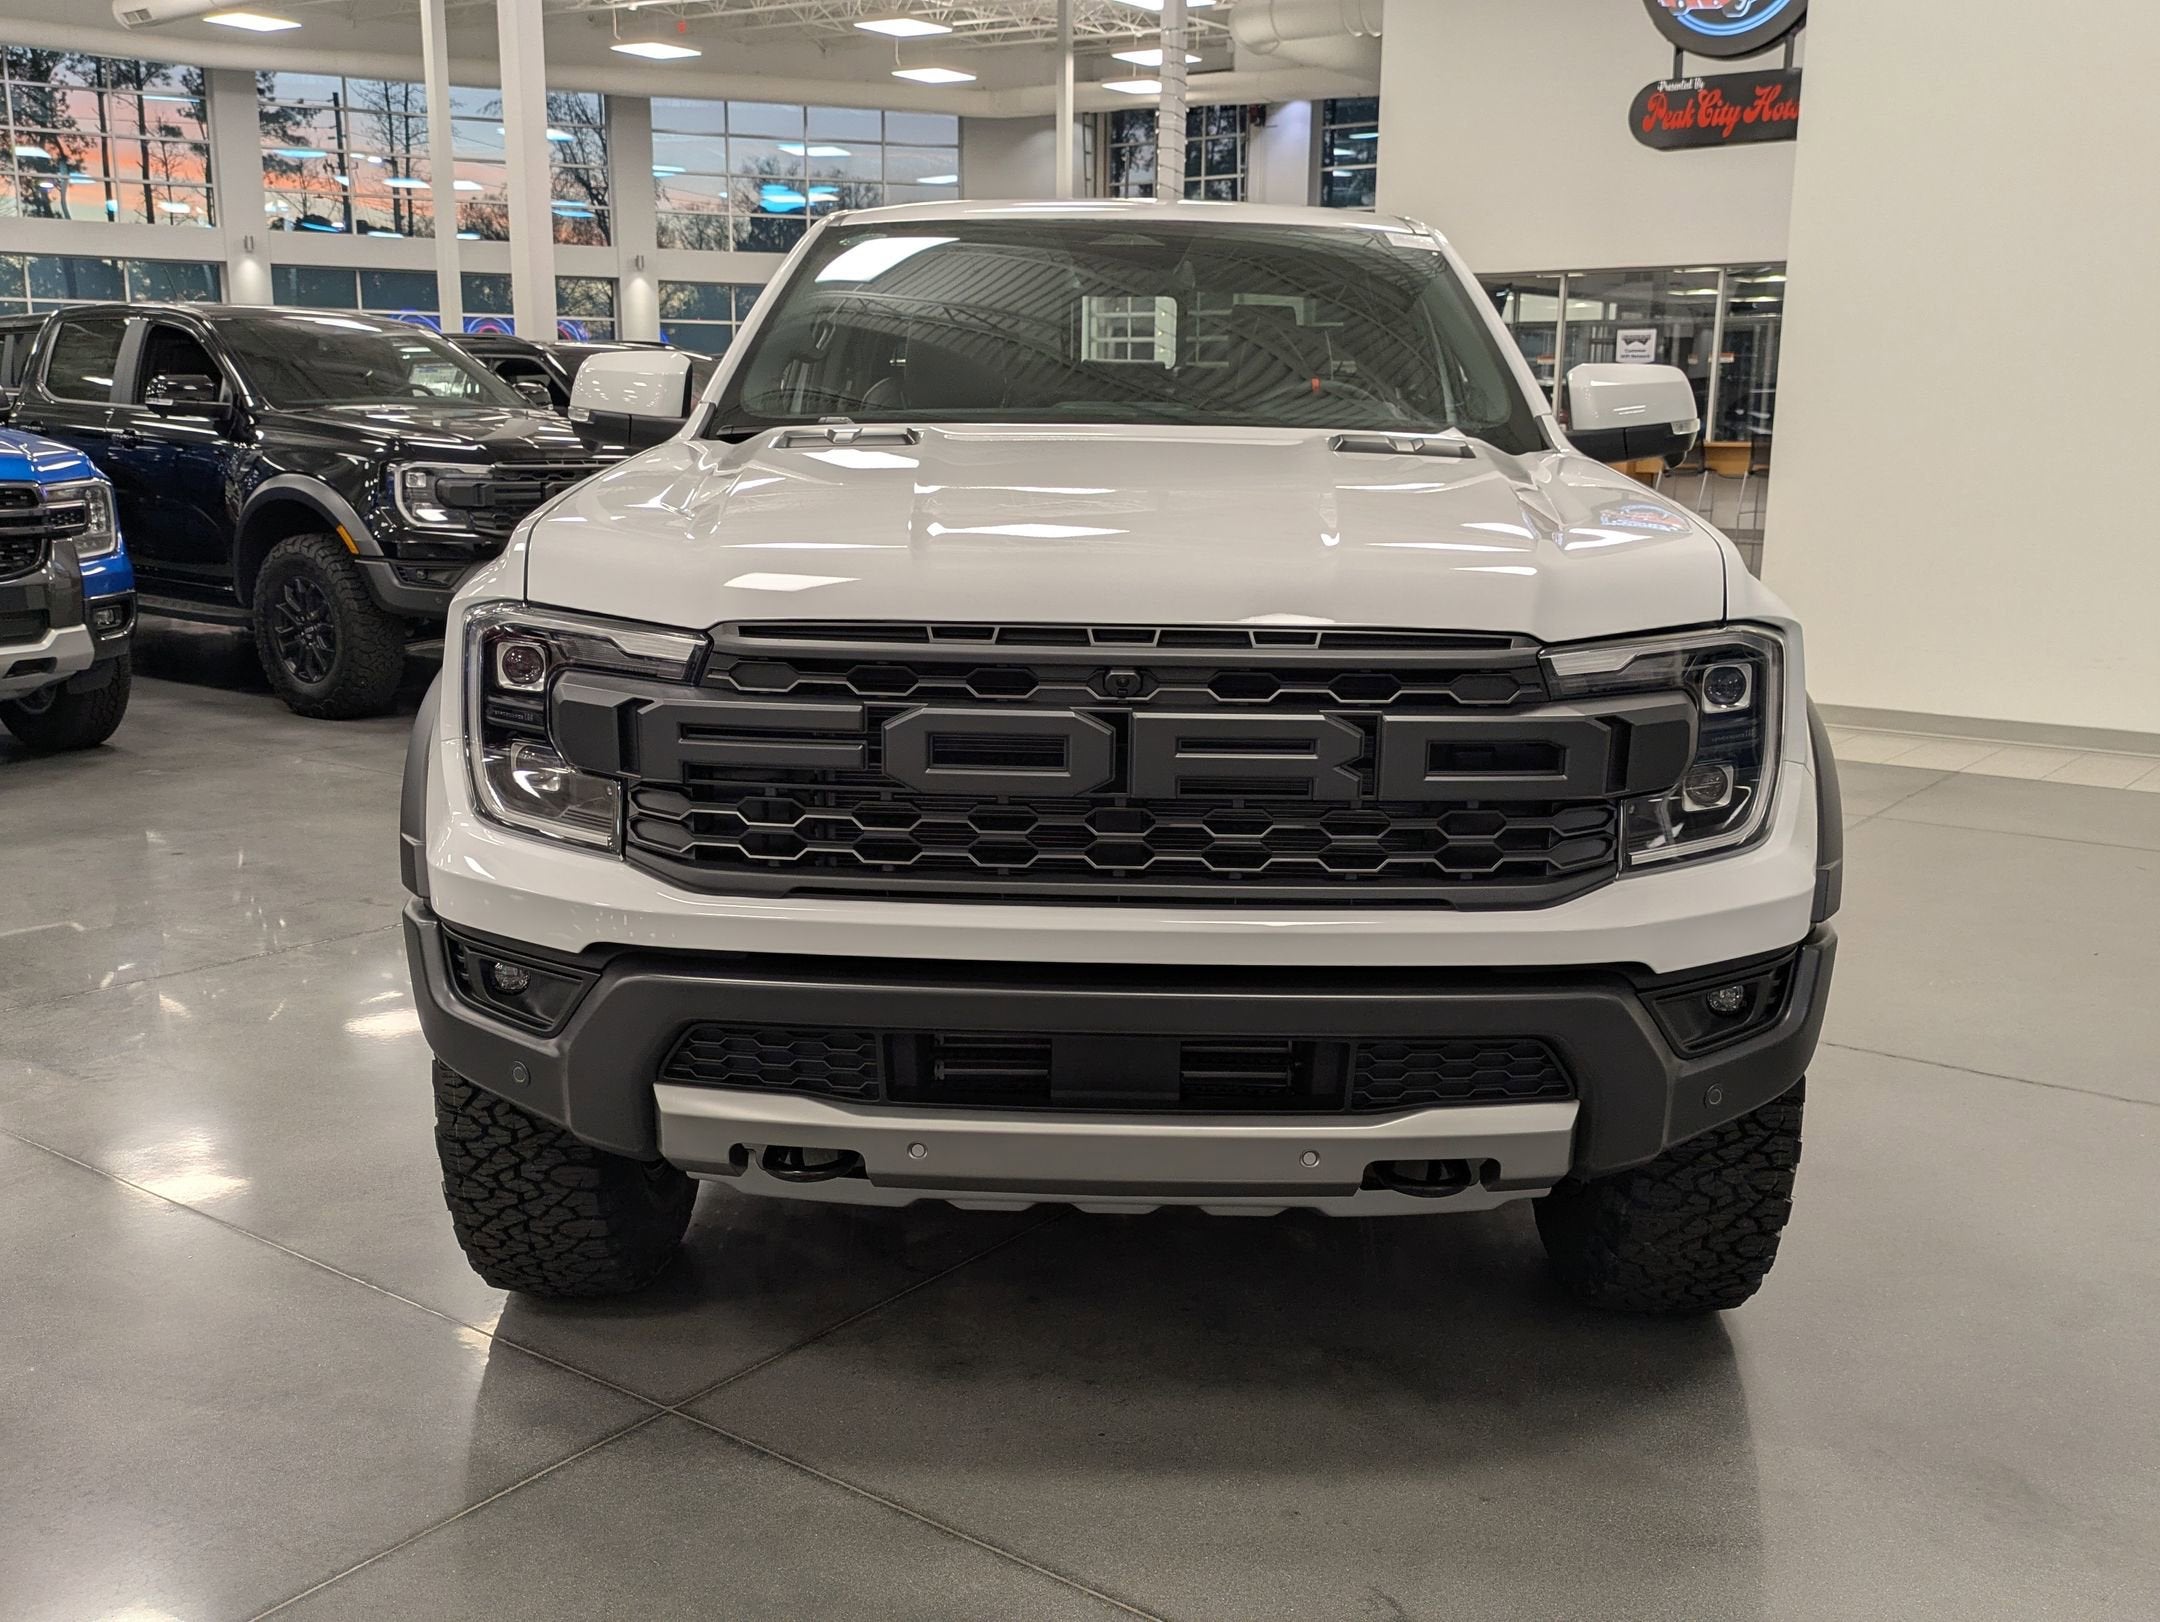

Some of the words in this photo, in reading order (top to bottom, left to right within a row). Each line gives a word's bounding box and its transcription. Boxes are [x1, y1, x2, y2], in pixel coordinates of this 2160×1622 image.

[1657, 79, 1693, 92] Presented
[1642, 92, 1695, 133] Peak
[1697, 87, 1741, 138] City
[637, 697, 1612, 801] FORD
